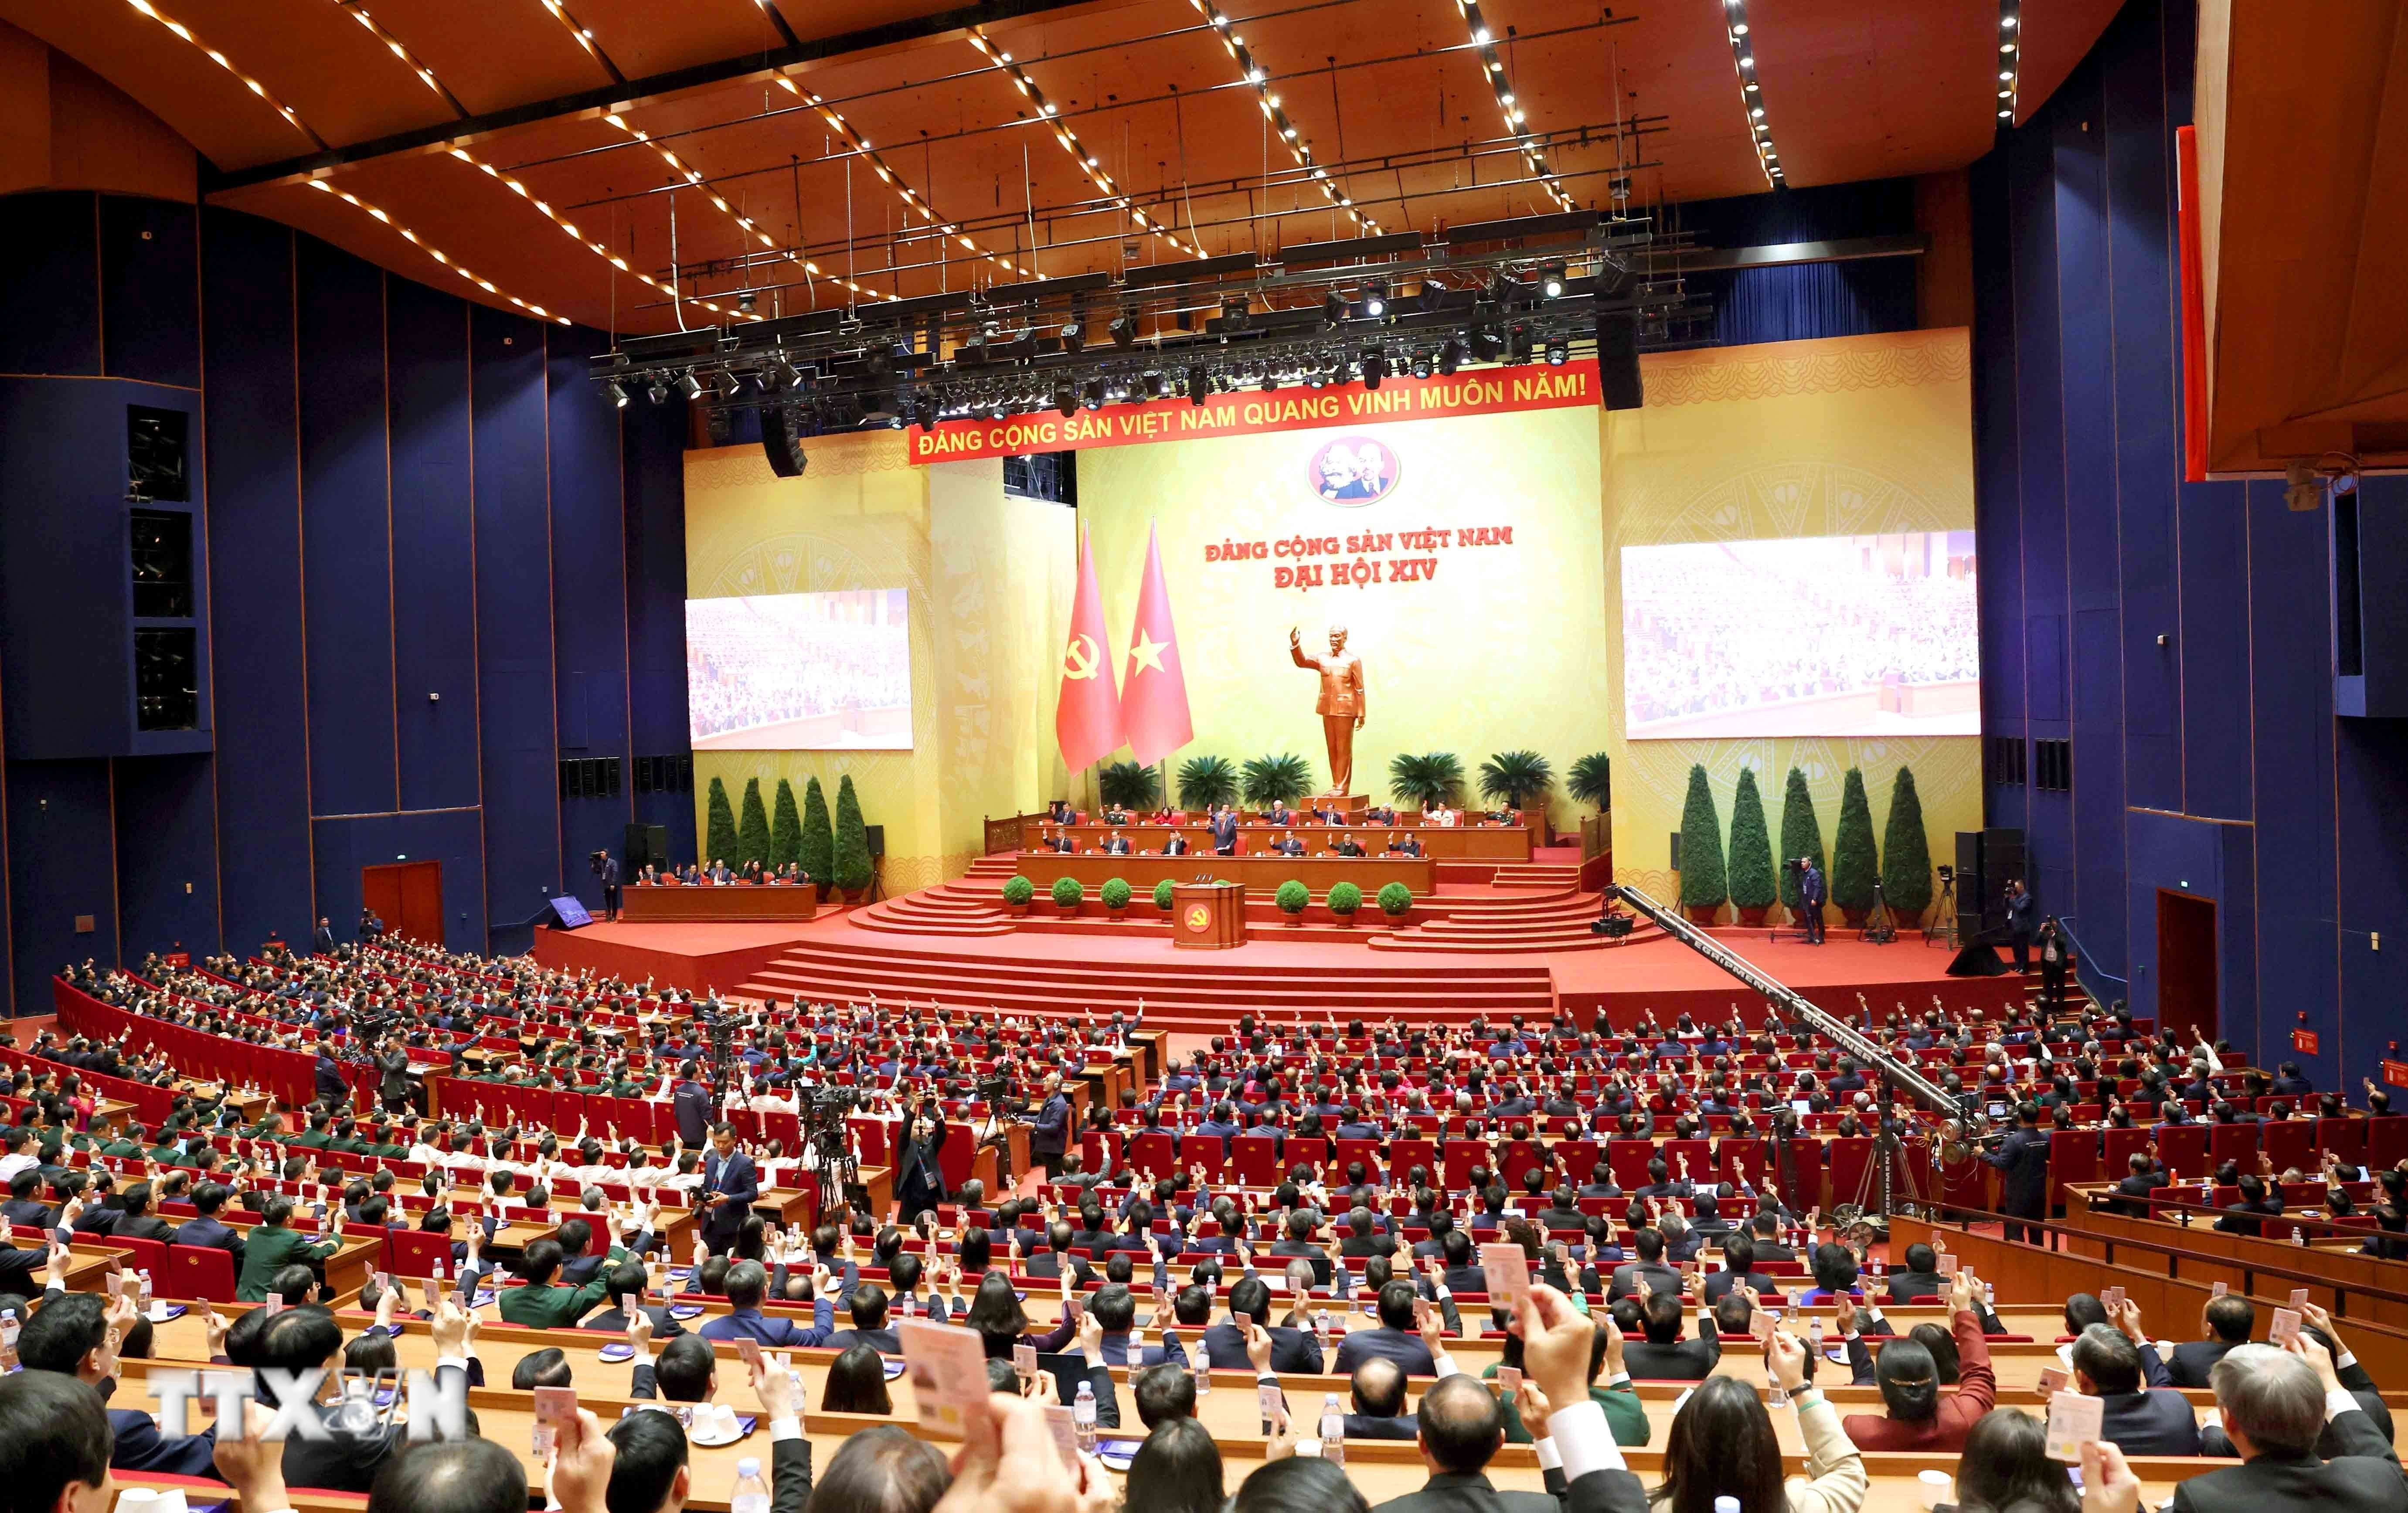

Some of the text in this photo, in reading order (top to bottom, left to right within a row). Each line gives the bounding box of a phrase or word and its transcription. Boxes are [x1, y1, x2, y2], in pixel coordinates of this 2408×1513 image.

[918, 371, 1586, 455] ĐẢNG CỘNG SẢN VIỆT NAM QUANG VINH MUÔN NĂM!
[1205, 526, 1513, 562] ĐẢNG CỘNG SẢN VIỆT NAM
[1275, 557, 1438, 592] ĐẠI HỘI XIV
[1802, 1012, 1873, 1064] SCANNER
